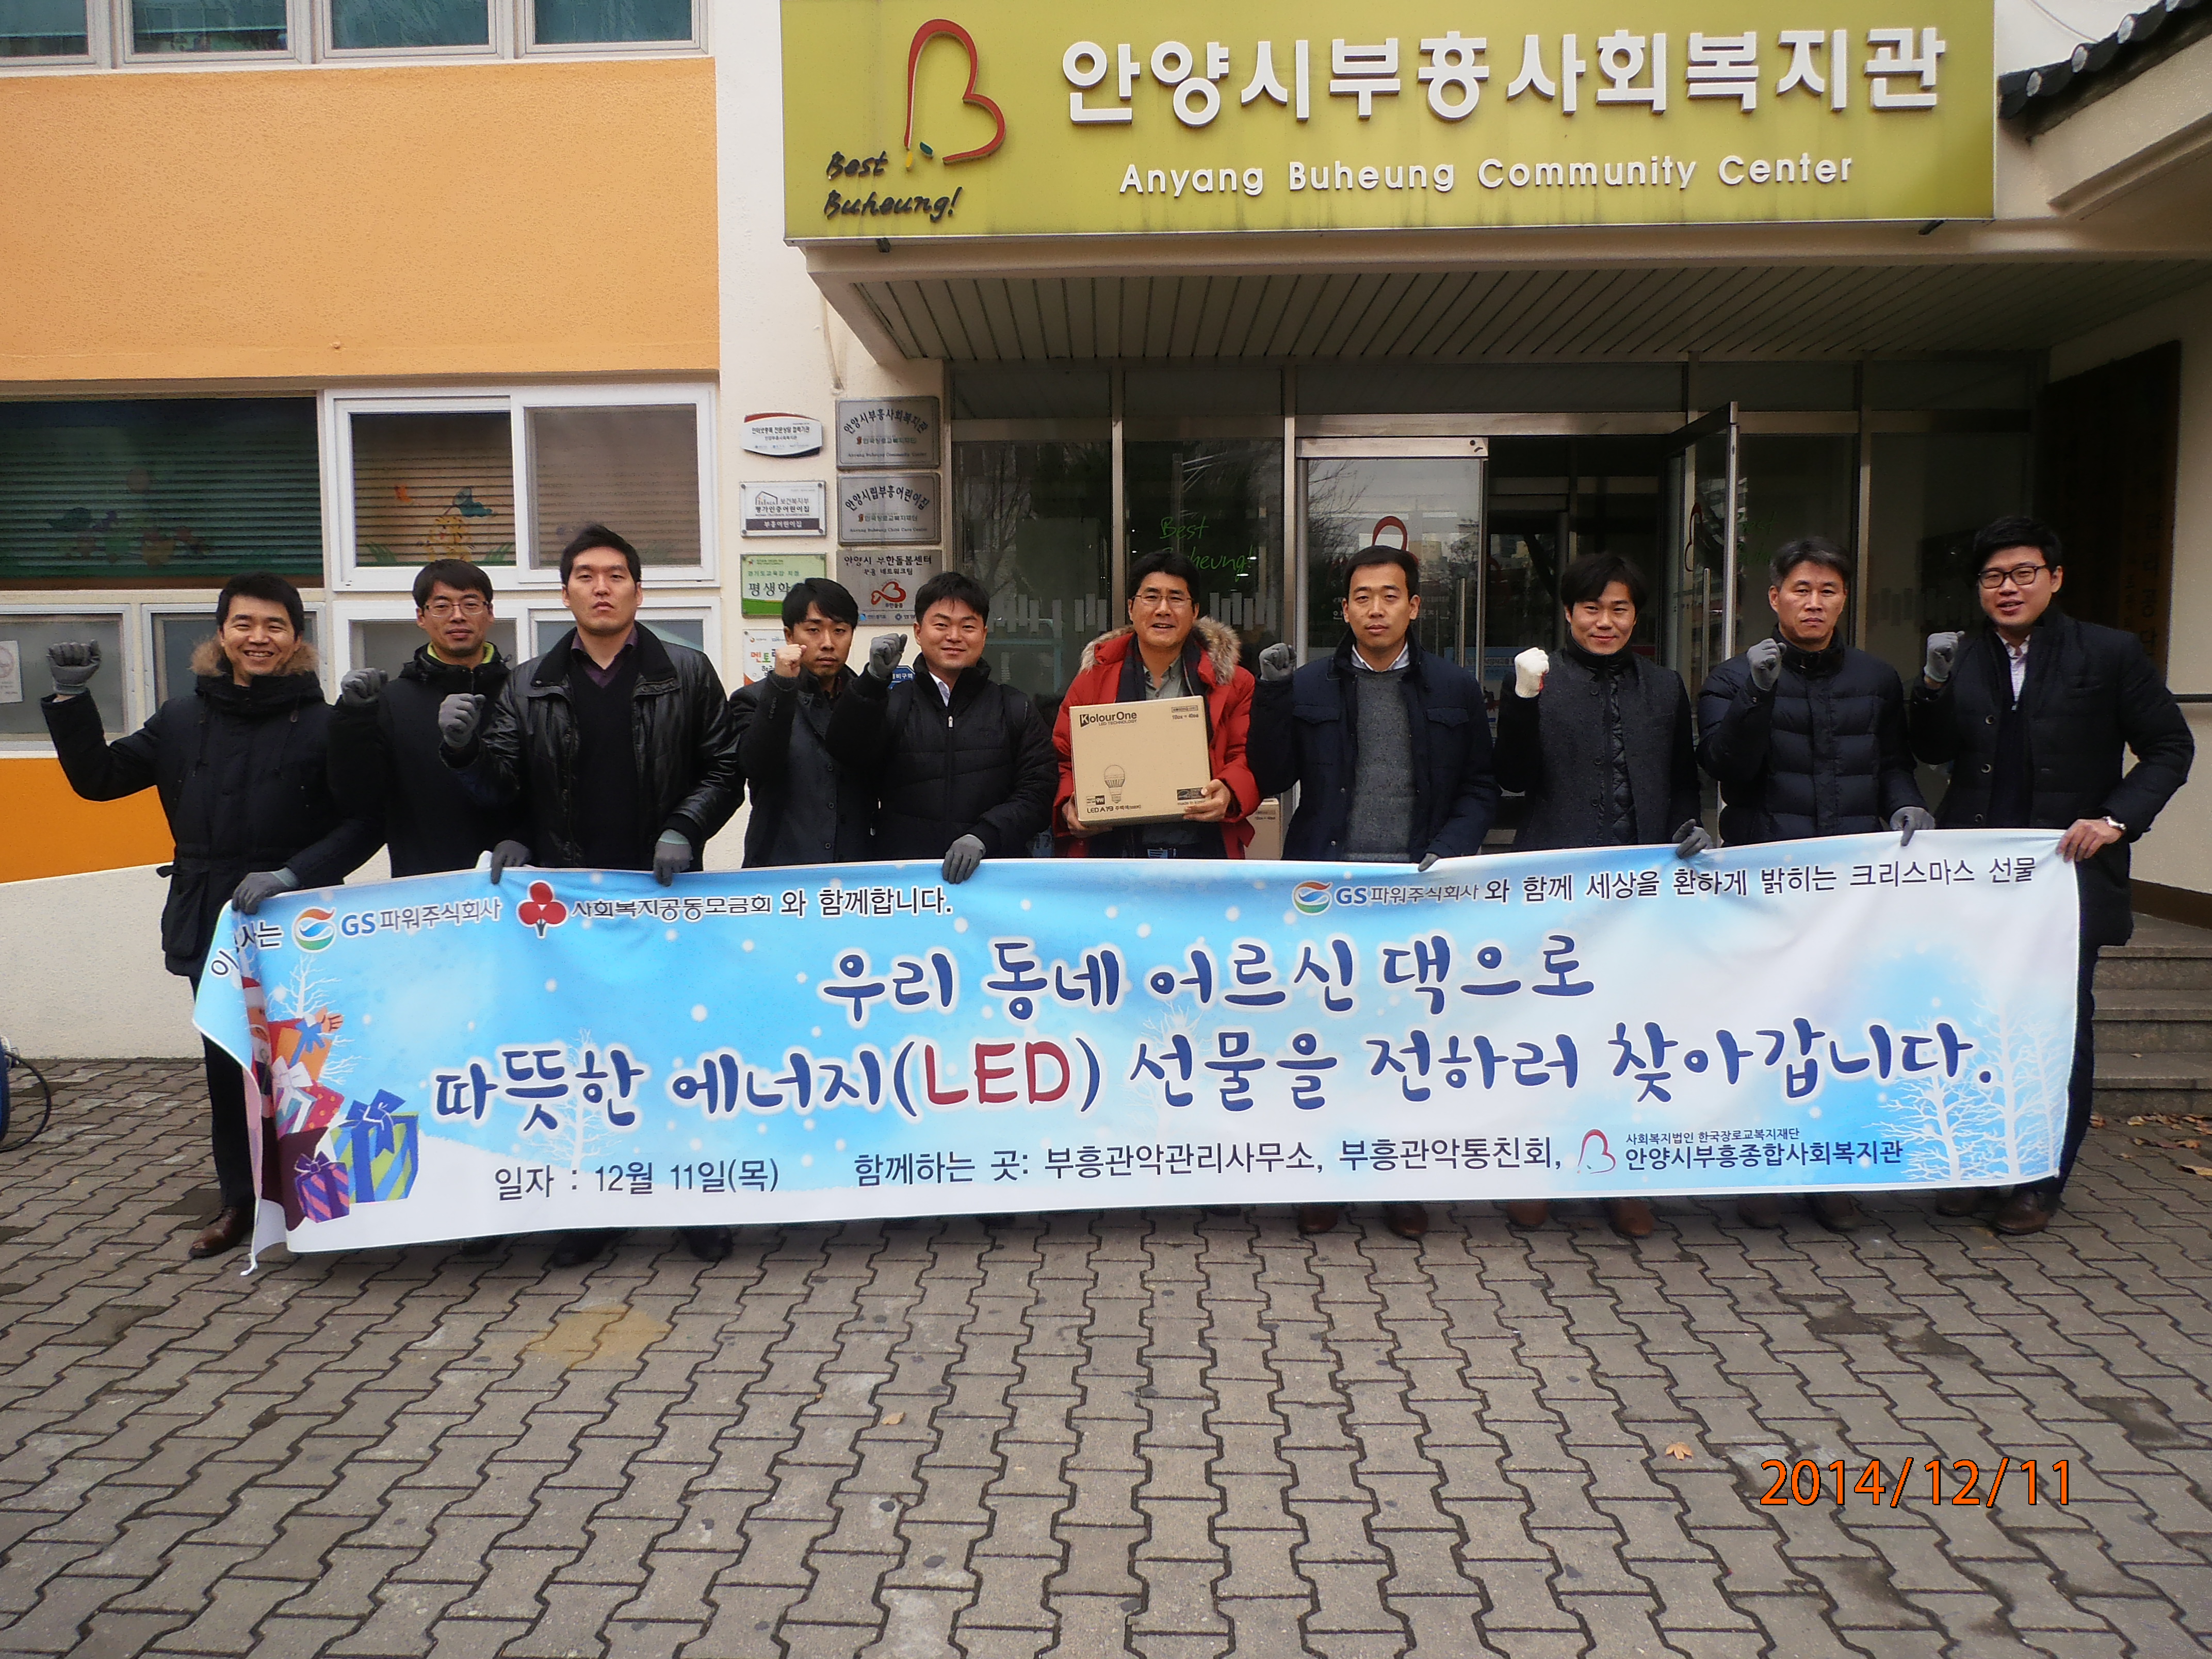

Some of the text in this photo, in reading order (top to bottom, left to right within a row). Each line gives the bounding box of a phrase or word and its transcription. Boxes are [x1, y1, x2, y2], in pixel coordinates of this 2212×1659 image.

[1062, 27, 1946, 127] 안양시부흥사회복지관
[826, 151, 888, 180] Best
[1119, 152, 1852, 197] Anyang Buheung Community Center
[824, 186, 963, 223] Buheung!
[845, 485, 930, 511] 안양시립부흥어린이집
[1160, 516, 1209, 540] Best
[1079, 711, 1137, 727] KolourOne
[1484, 879, 1510, 904] 와
[1522, 874, 1573, 902] 함께
[1586, 870, 1660, 900] 세상을
[1673, 867, 1748, 897] 환하게
[1760, 866, 1838, 894] 밝히는
[1850, 858, 1975, 887] 크리스마스
[1988, 856, 2037, 884] 선물
[572, 886, 952, 921] 사회복지공동모금회 와 함께합니다.
[824, 935, 1595, 1022] 우리 동네 어르신 댁으로
[436, 1017, 1992, 1132] 따뜻한 에너지(LED) 선물을 전하러 찾아갑니다.
[1625, 1127, 1800, 1145] 사회복지법인 한국장로교복지재단
[854, 1136, 1562, 1186] 함께하는 곳: 부흥관악관리사무소, 부흥관악통친회,
[1624, 1140, 1903, 1171] 안양시부흥종합사회복지관
[495, 1164, 555, 1201] 일자
[594, 1161, 654, 1194] 12월
[670, 1158, 778, 1194] 11일(목)
